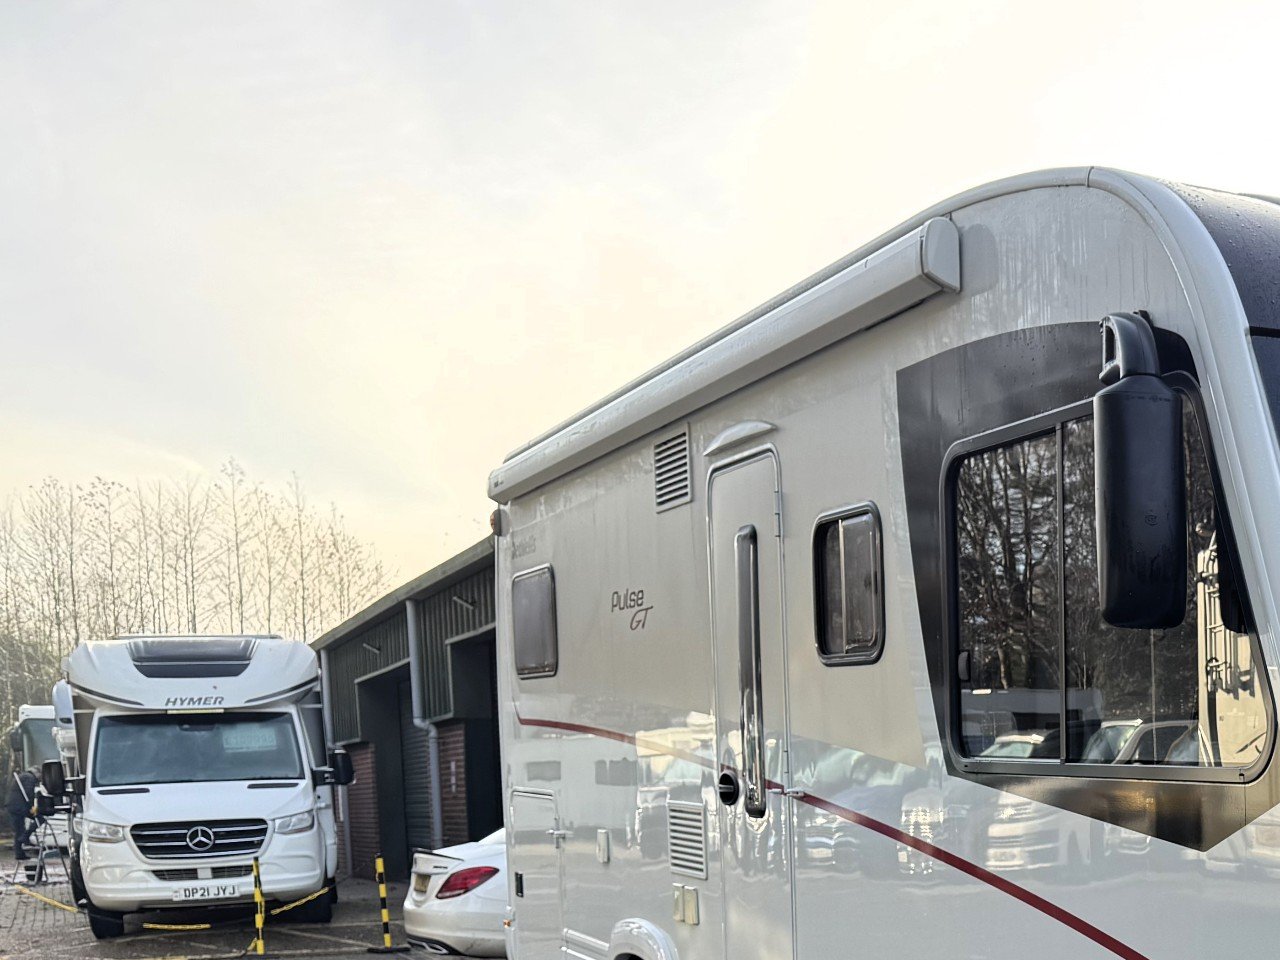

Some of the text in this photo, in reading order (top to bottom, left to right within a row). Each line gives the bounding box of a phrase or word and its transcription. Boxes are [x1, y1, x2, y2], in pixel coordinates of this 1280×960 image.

[611, 588, 645, 613] Pulse
[630, 605, 654, 631] GT
[165, 696, 225, 707] HYMER
[183, 884, 237, 898] DP21 JYJ
